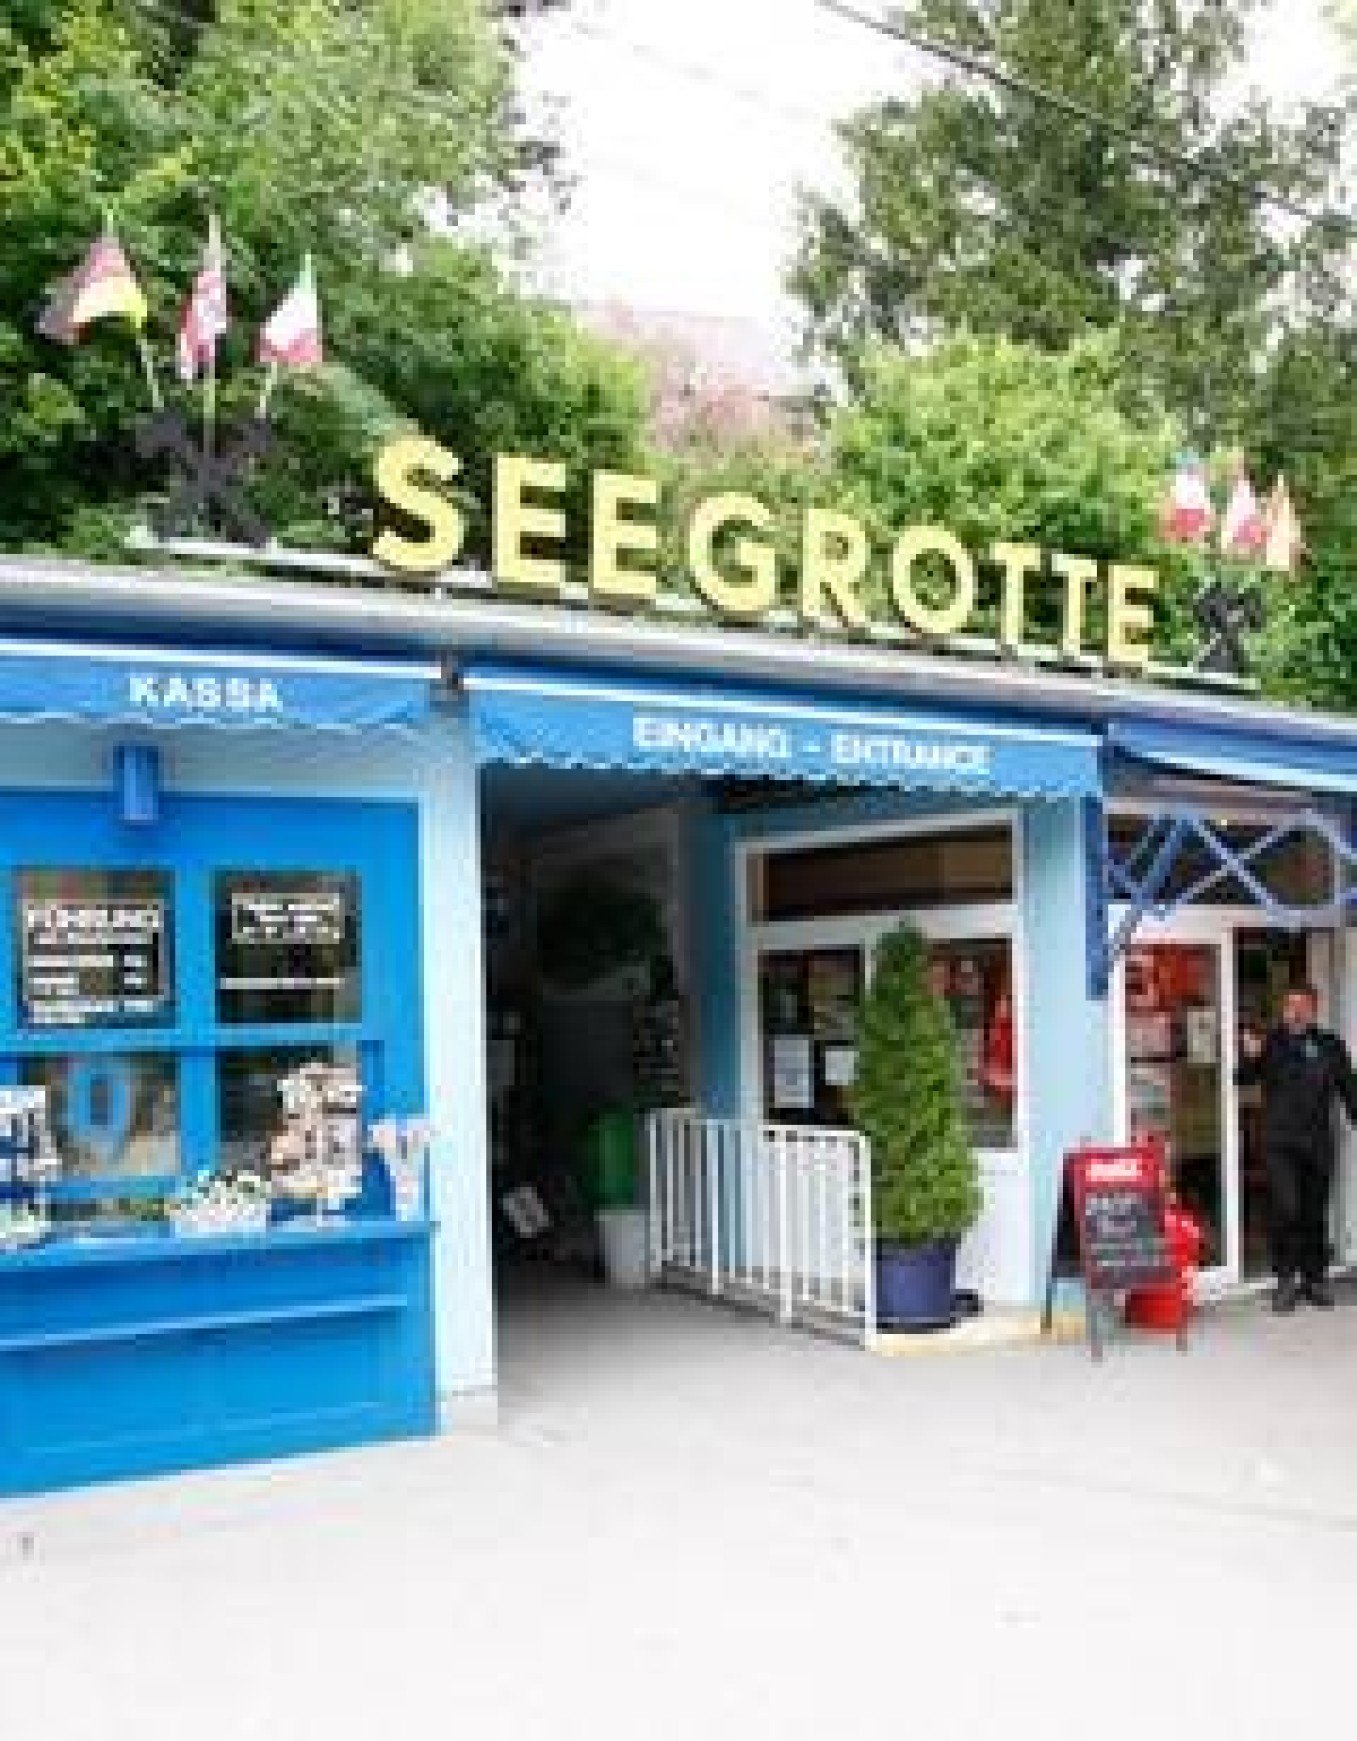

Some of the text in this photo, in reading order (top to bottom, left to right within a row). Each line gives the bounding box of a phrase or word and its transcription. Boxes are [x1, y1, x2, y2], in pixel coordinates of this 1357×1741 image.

[371, 436, 1160, 664] SEEGROTTE
[129, 675, 283, 713] KASSA
[632, 716, 793, 759] EINGANG
[831, 734, 991, 776] ENTRANCE
